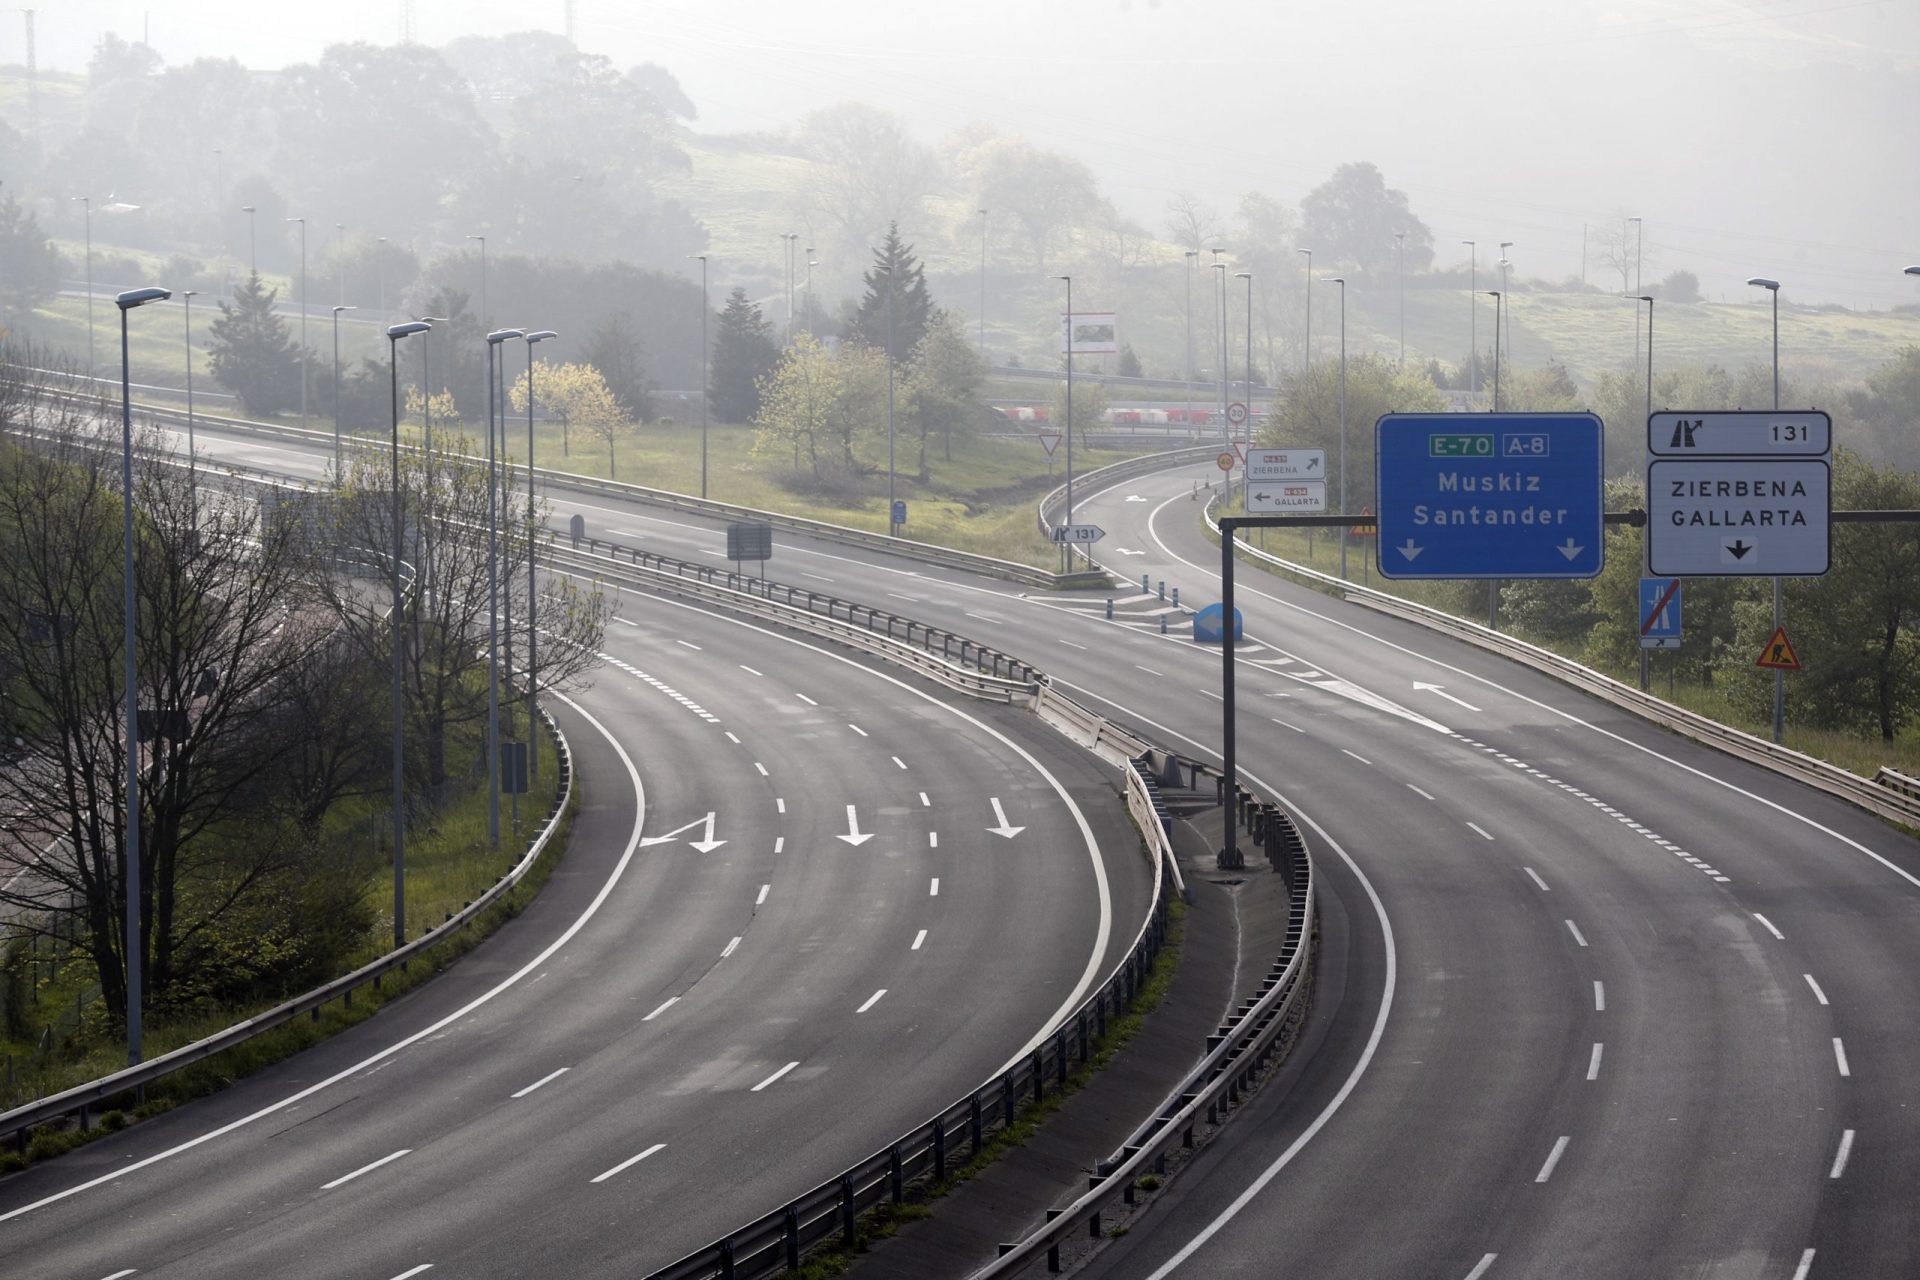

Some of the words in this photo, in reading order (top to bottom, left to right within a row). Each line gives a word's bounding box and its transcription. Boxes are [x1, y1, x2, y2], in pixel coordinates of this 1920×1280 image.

[1231, 408, 1243, 417] 30
[1772, 425, 1807, 441] 131
[1434, 438, 1490, 454] E-70
[1508, 438, 1545, 454] A-8
[1220, 458, 1232, 466] 40
[1253, 466, 1298, 475] ZIERBENA
[1439, 472, 1541, 492] Muskiz
[1671, 481, 1806, 497] ZIERBENA
[1275, 497, 1320, 506] GALLARTA
[1413, 505, 1568, 525] Santander
[1671, 510, 1807, 526] GALLARTA
[1076, 528, 1095, 539] 131
